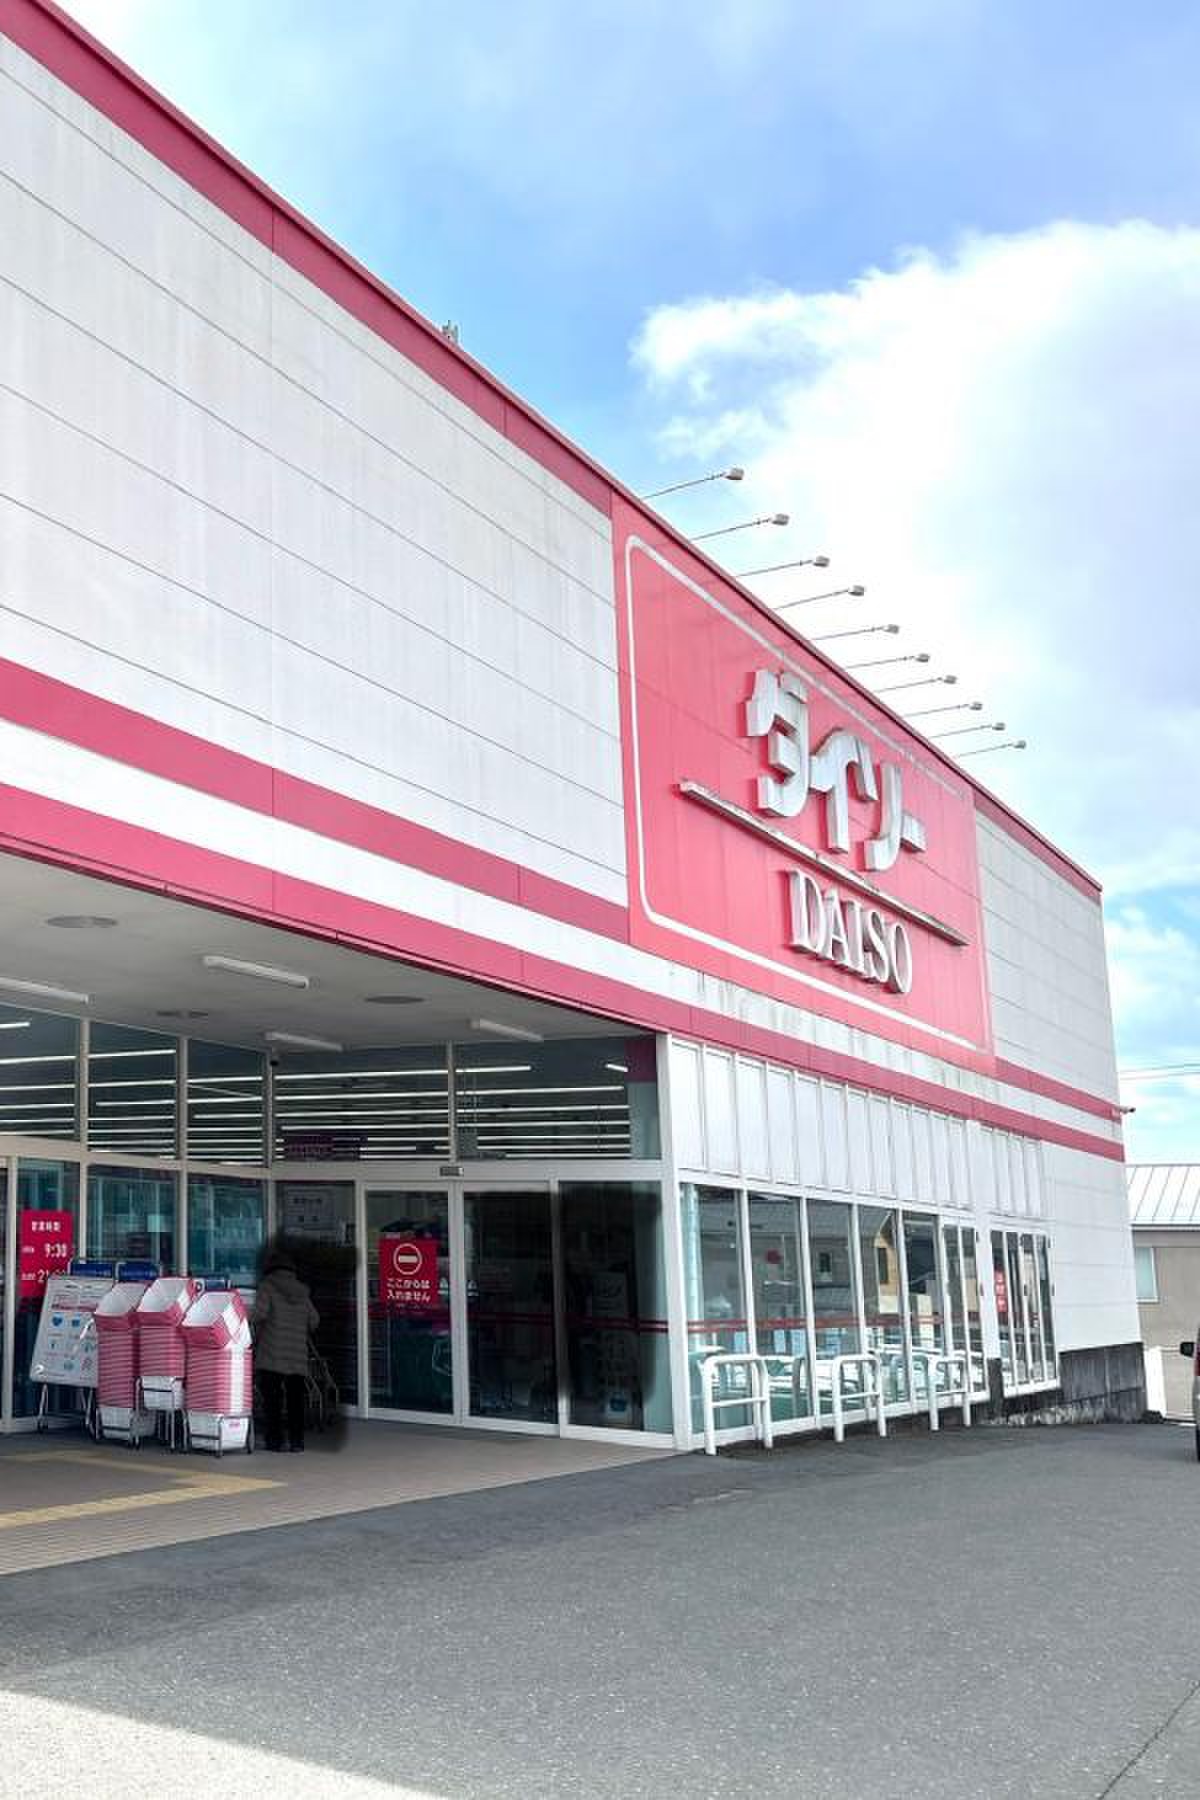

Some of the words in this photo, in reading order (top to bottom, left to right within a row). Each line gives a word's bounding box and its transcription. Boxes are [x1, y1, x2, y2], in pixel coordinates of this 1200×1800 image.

[744, 670, 926, 872] ダイソー
[784, 869, 912, 994] DAISO
[44, 1243, 67, 1258] 9:30
[386, 1278, 430, 1289] ここからは
[386, 1289, 431, 1303] 入れません
